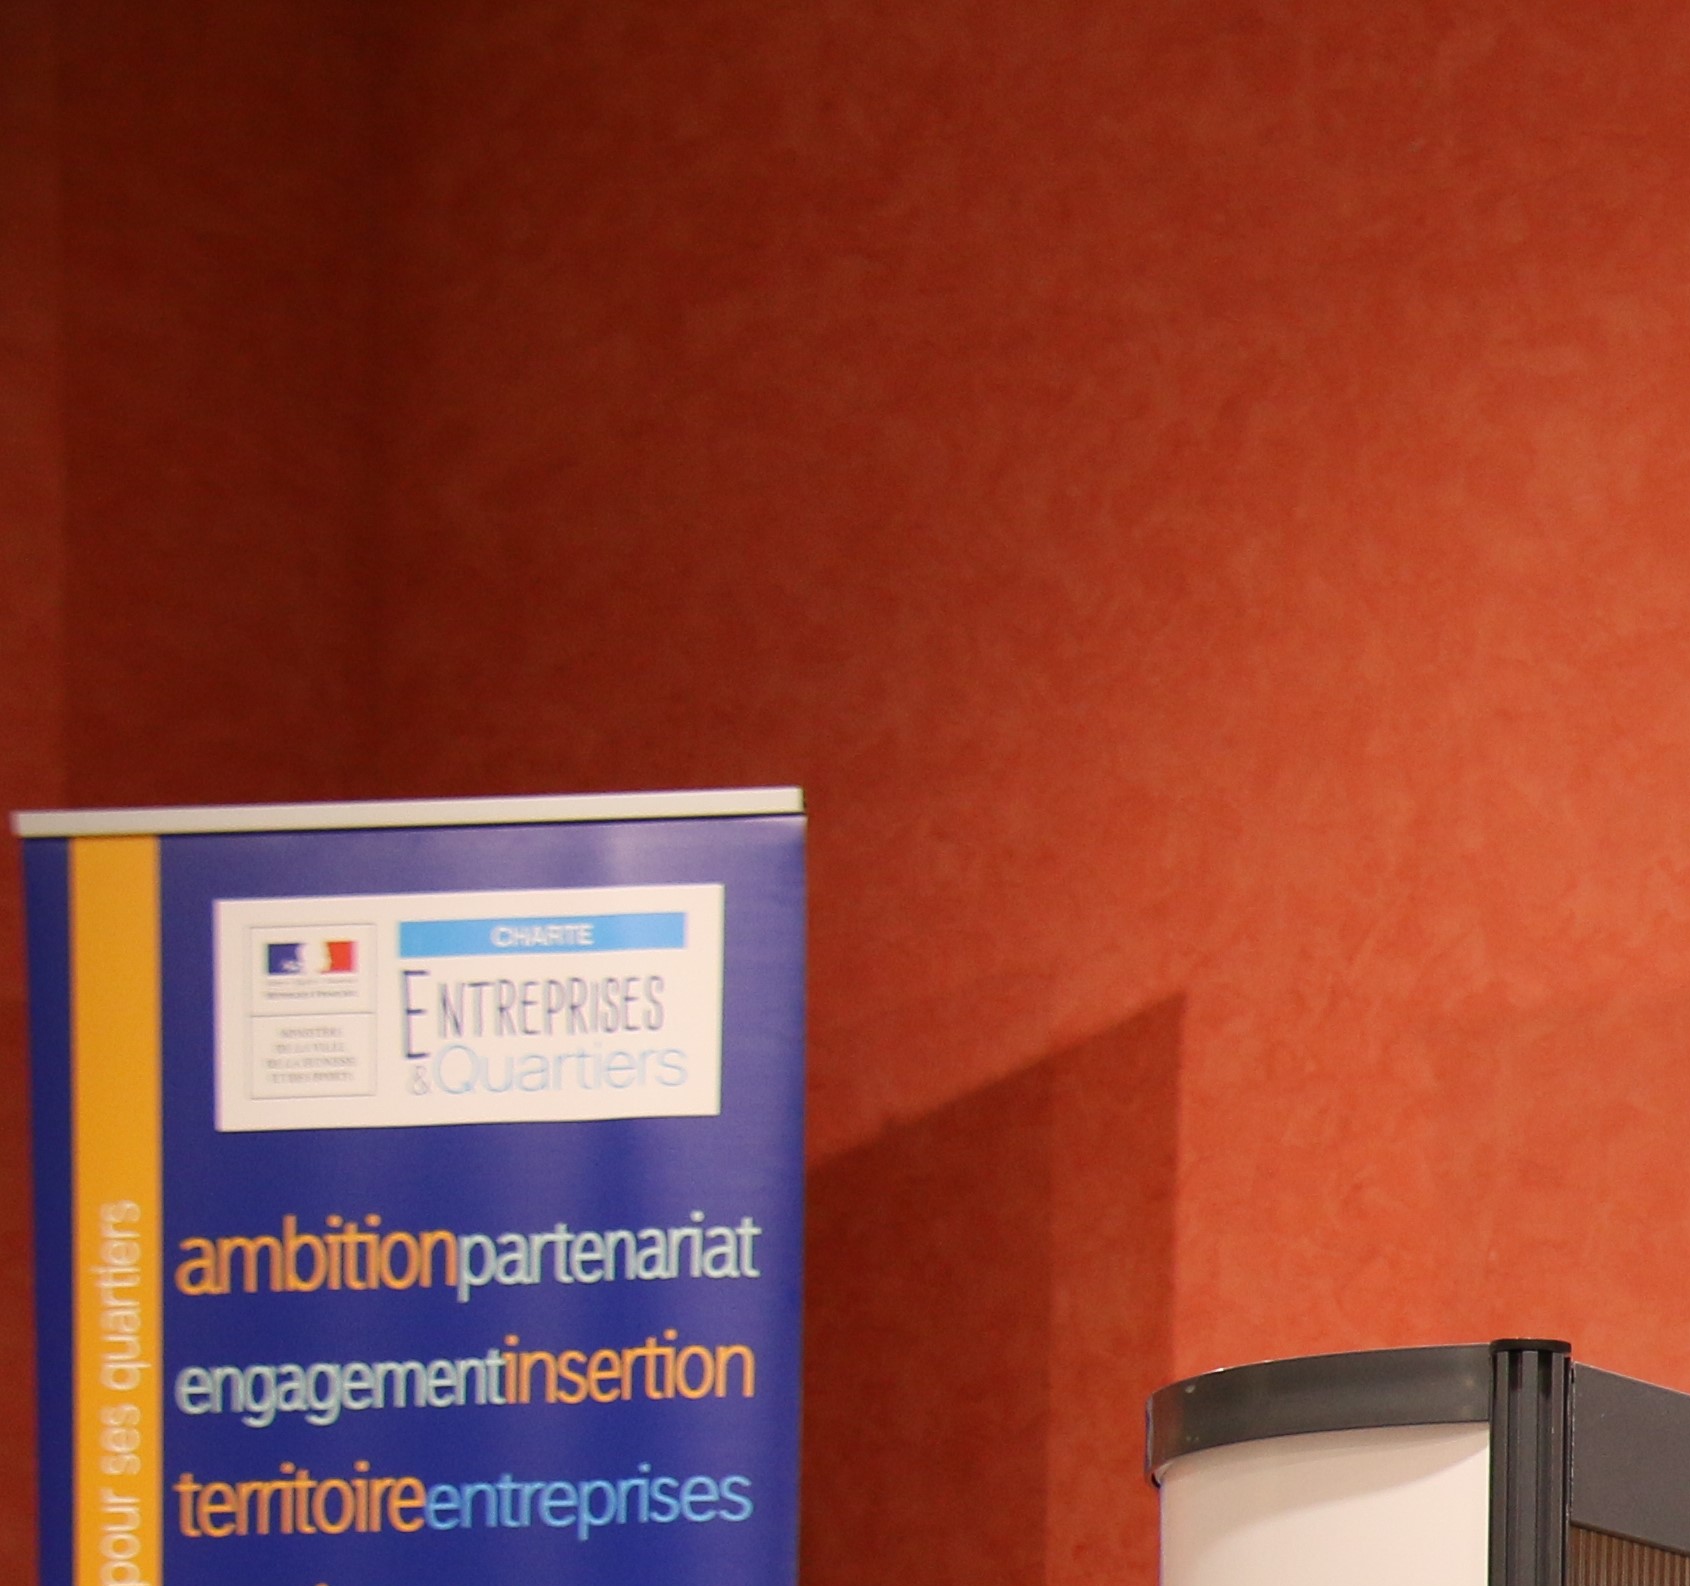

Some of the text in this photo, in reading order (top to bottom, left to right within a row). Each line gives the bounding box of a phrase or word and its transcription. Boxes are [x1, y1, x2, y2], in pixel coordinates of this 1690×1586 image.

[490, 924, 594, 948] CHARTE
[402, 969, 665, 1060] ENTREPRISES
[89, 1199, 153, 1392] quartiers
[100, 1402, 142, 1476] ses
